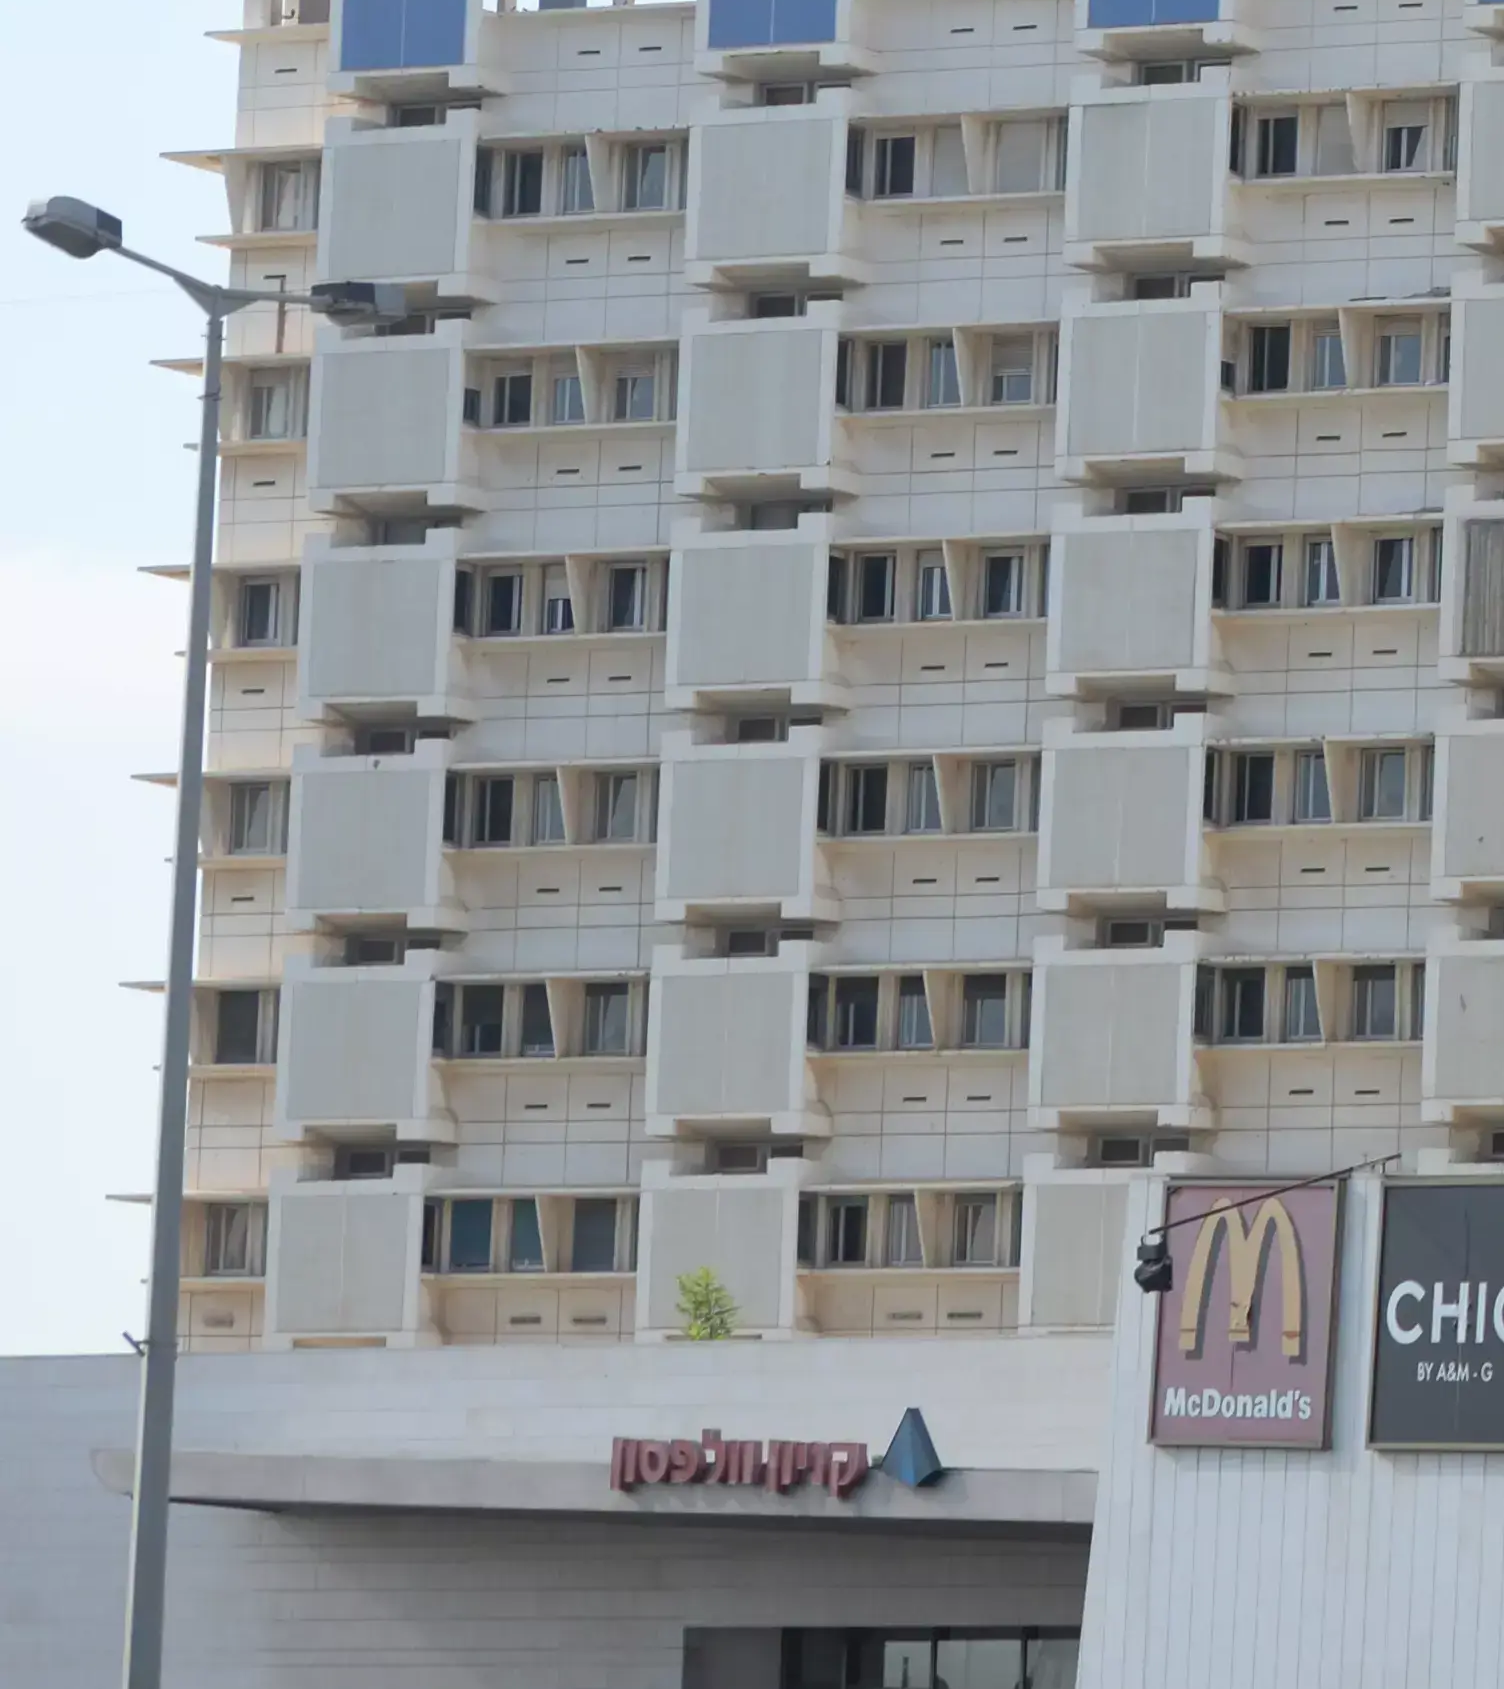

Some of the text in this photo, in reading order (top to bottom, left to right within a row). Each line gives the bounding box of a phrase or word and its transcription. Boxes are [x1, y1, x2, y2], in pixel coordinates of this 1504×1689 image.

[1417, 1361, 1434, 1381] BY
[1164, 1387, 1312, 1420] McDonald's
[610, 1428, 763, 1492] וולפסון
